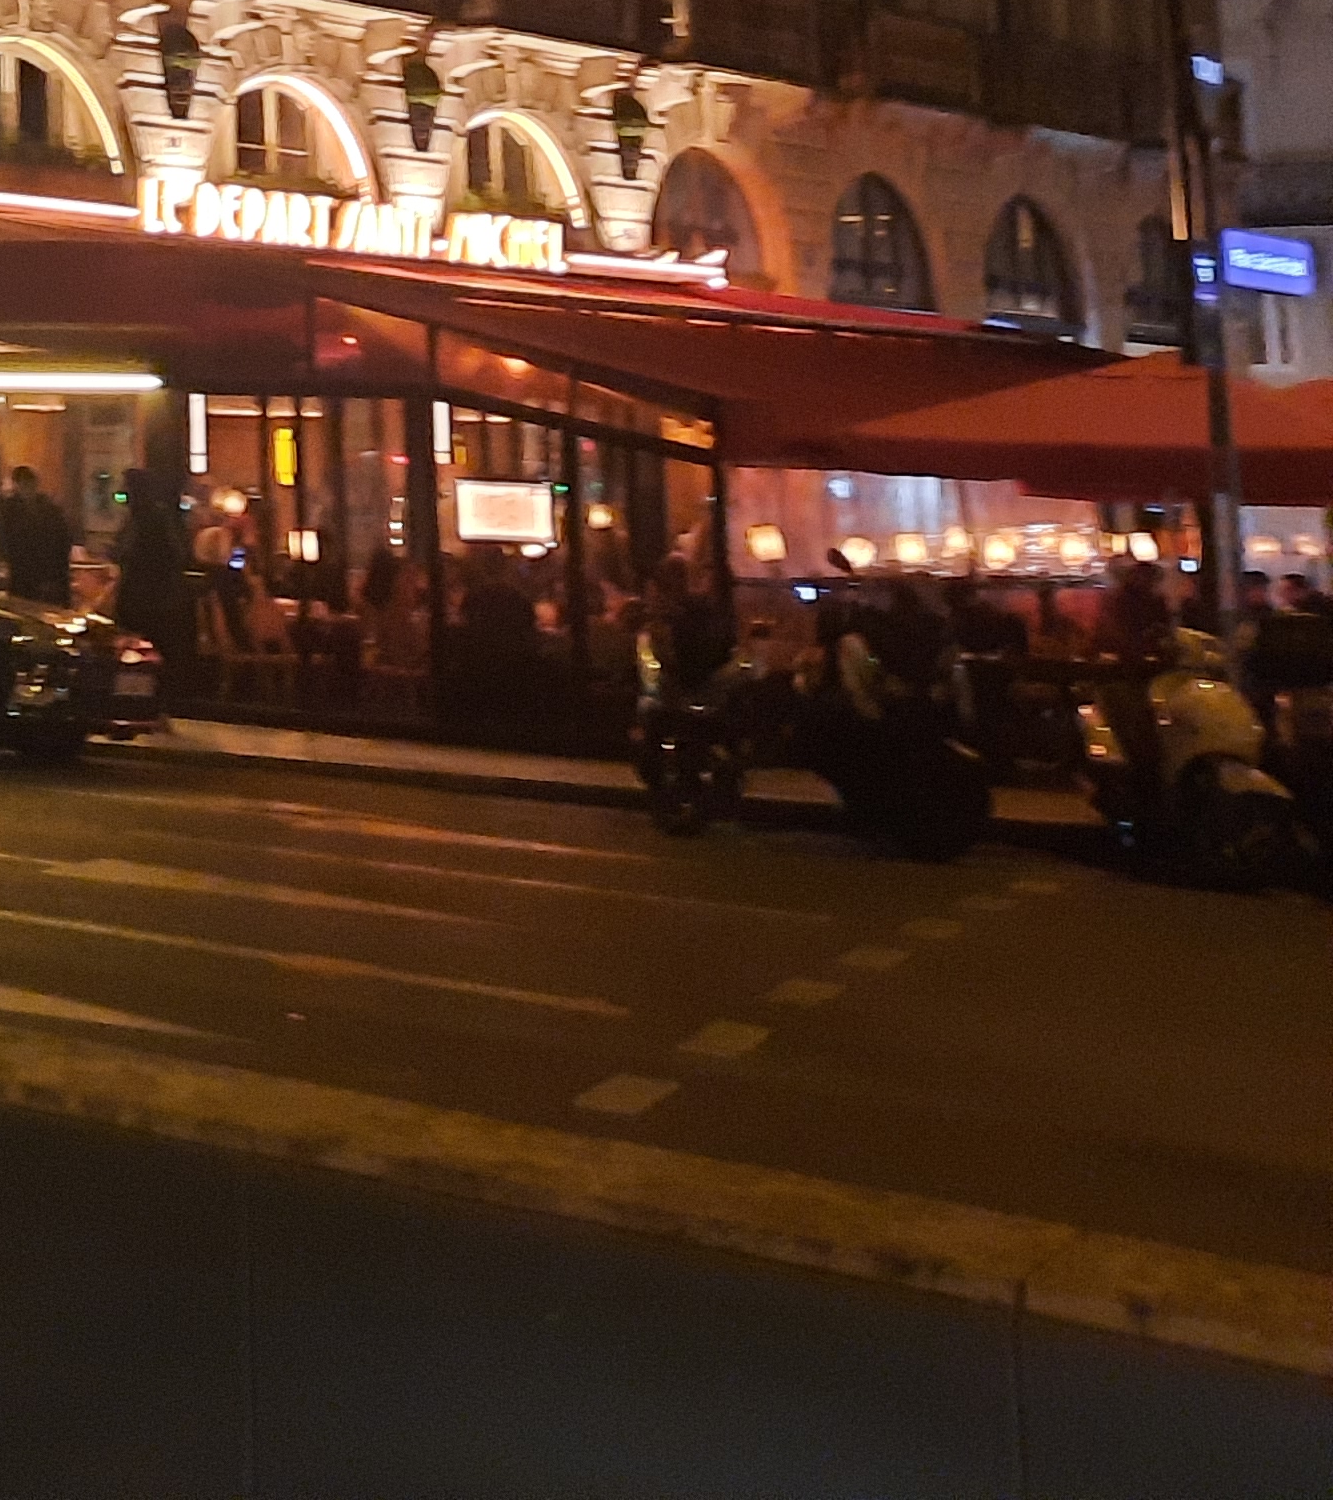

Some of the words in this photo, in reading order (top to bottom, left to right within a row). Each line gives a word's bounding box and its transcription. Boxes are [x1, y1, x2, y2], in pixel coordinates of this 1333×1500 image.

[138, 176, 185, 235] LE
[193, 181, 332, 249] DEPART
[333, 200, 569, 275] SAINT-MICHEL
